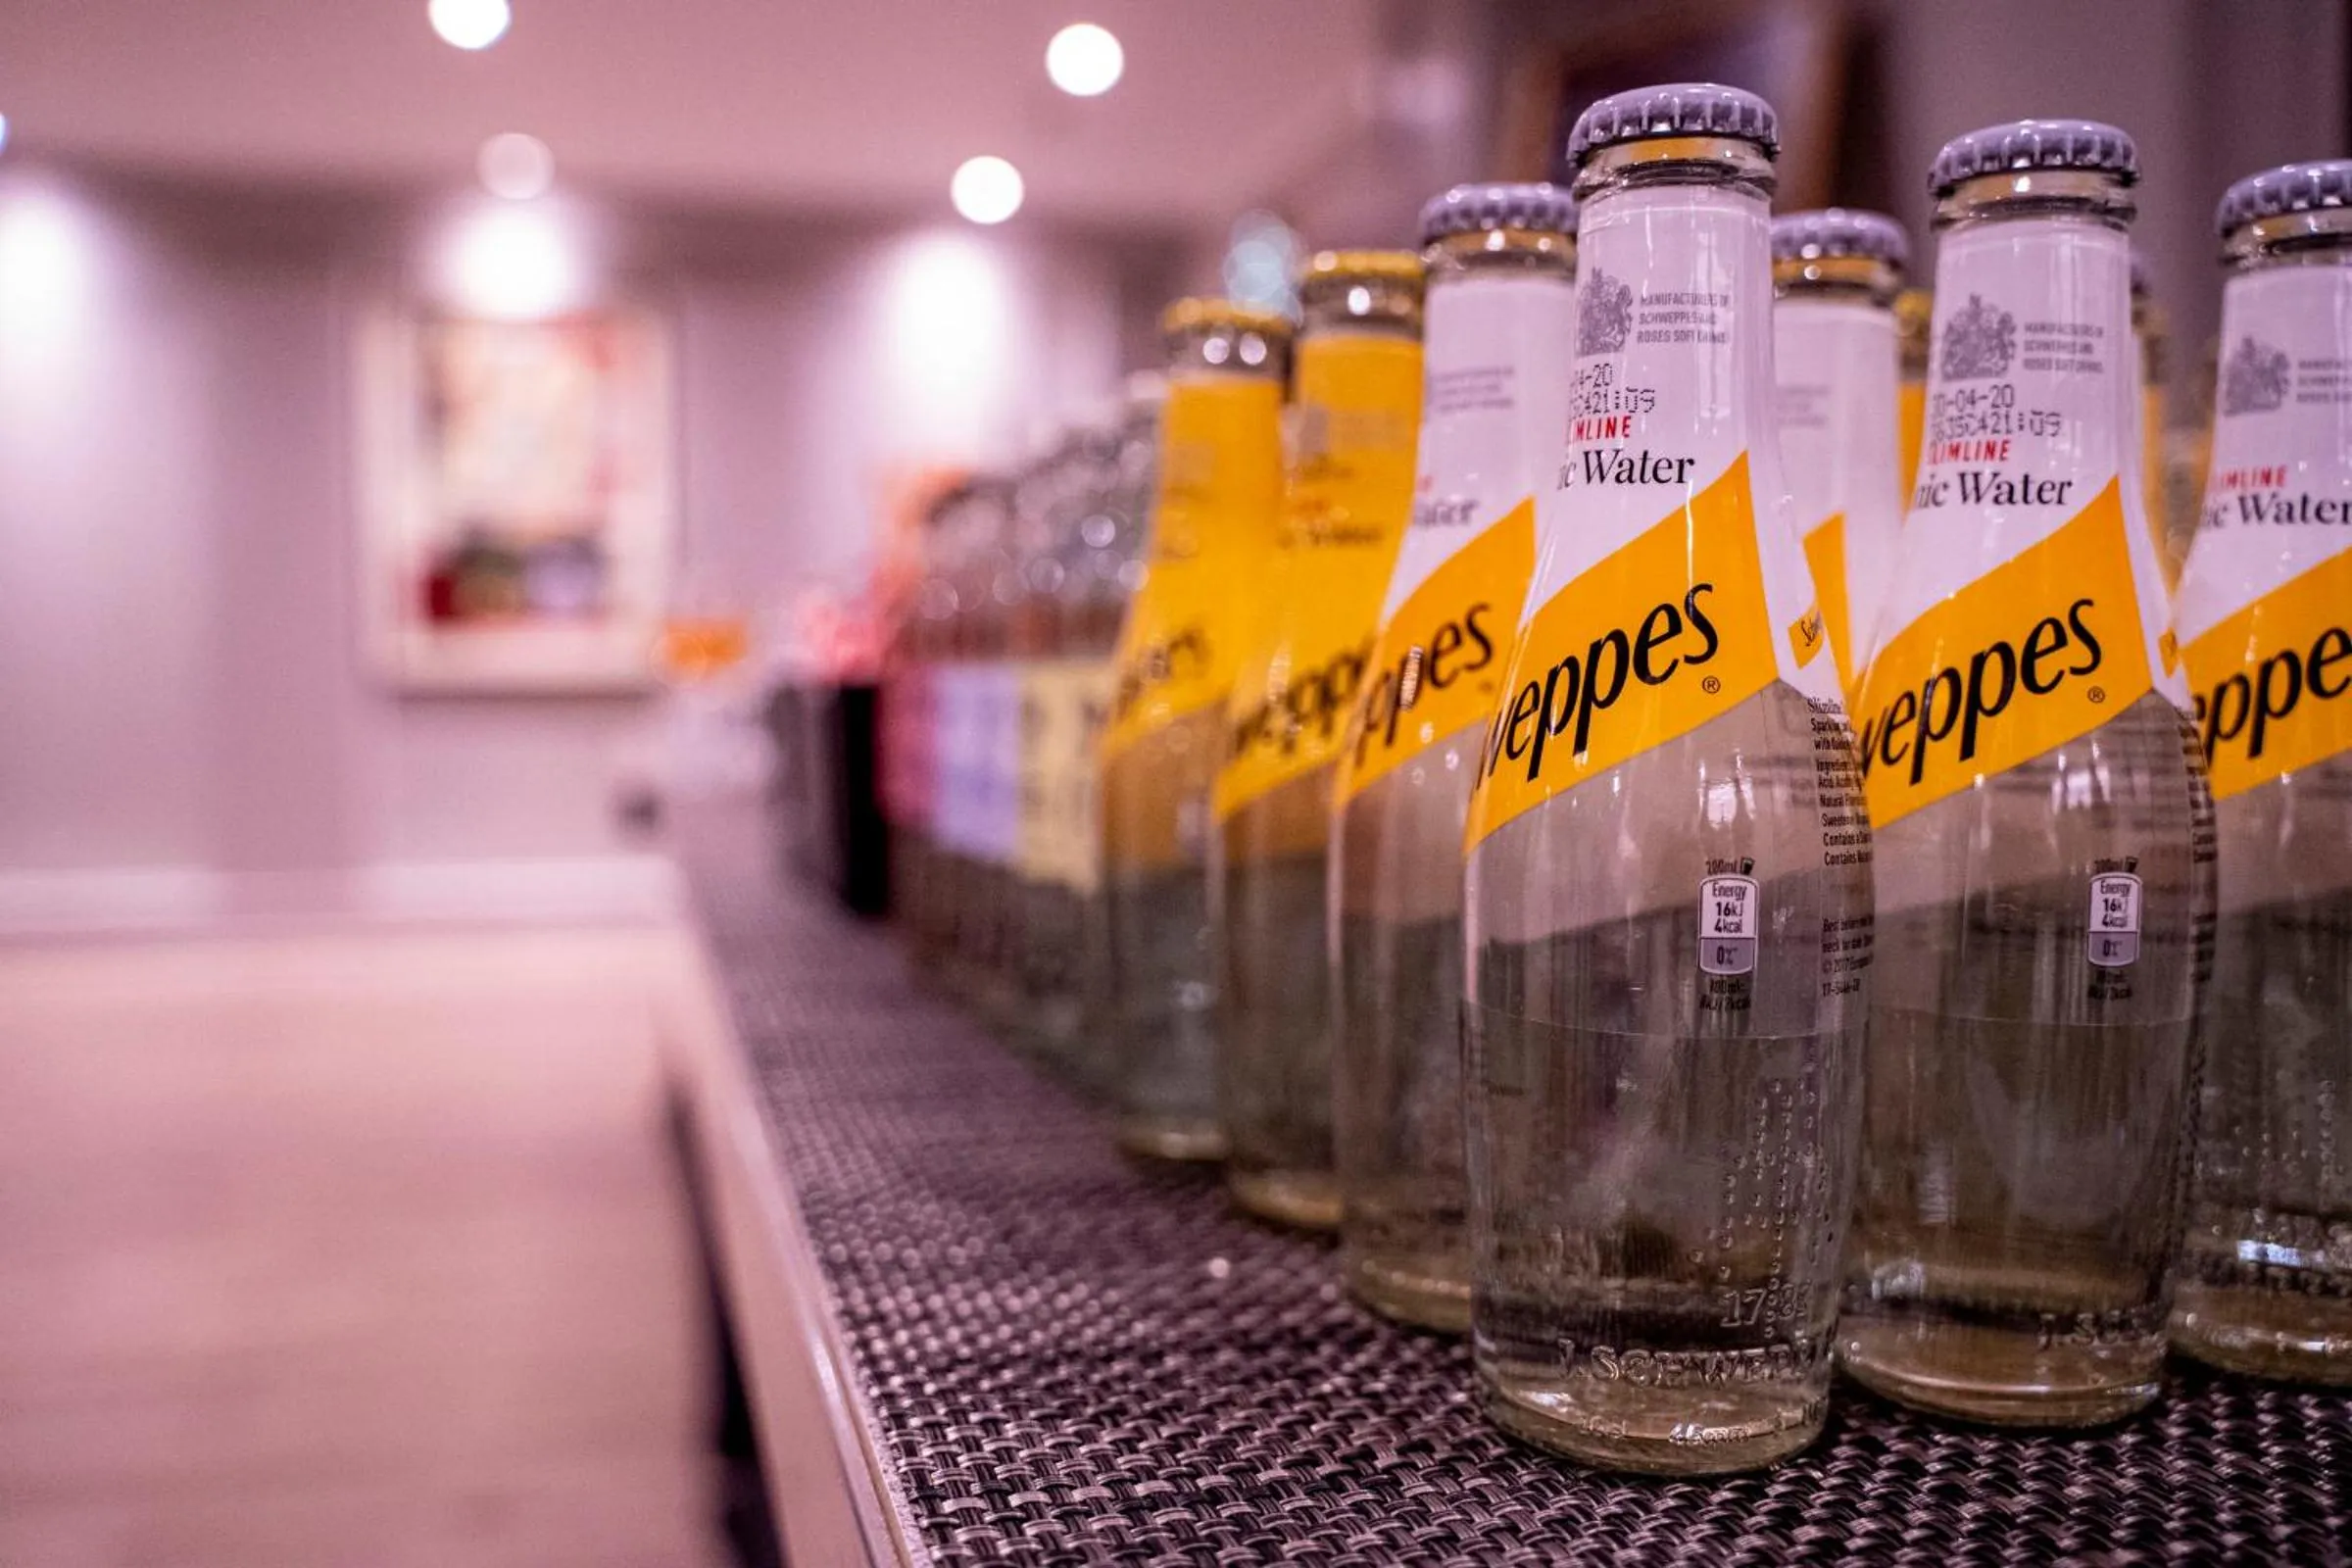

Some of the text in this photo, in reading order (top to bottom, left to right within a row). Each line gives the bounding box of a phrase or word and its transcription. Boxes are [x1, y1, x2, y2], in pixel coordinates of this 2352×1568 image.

[1583, 448, 1694, 484] Water
[1957, 470, 2074, 507] Water
[1712, 883, 1747, 901] Energy
